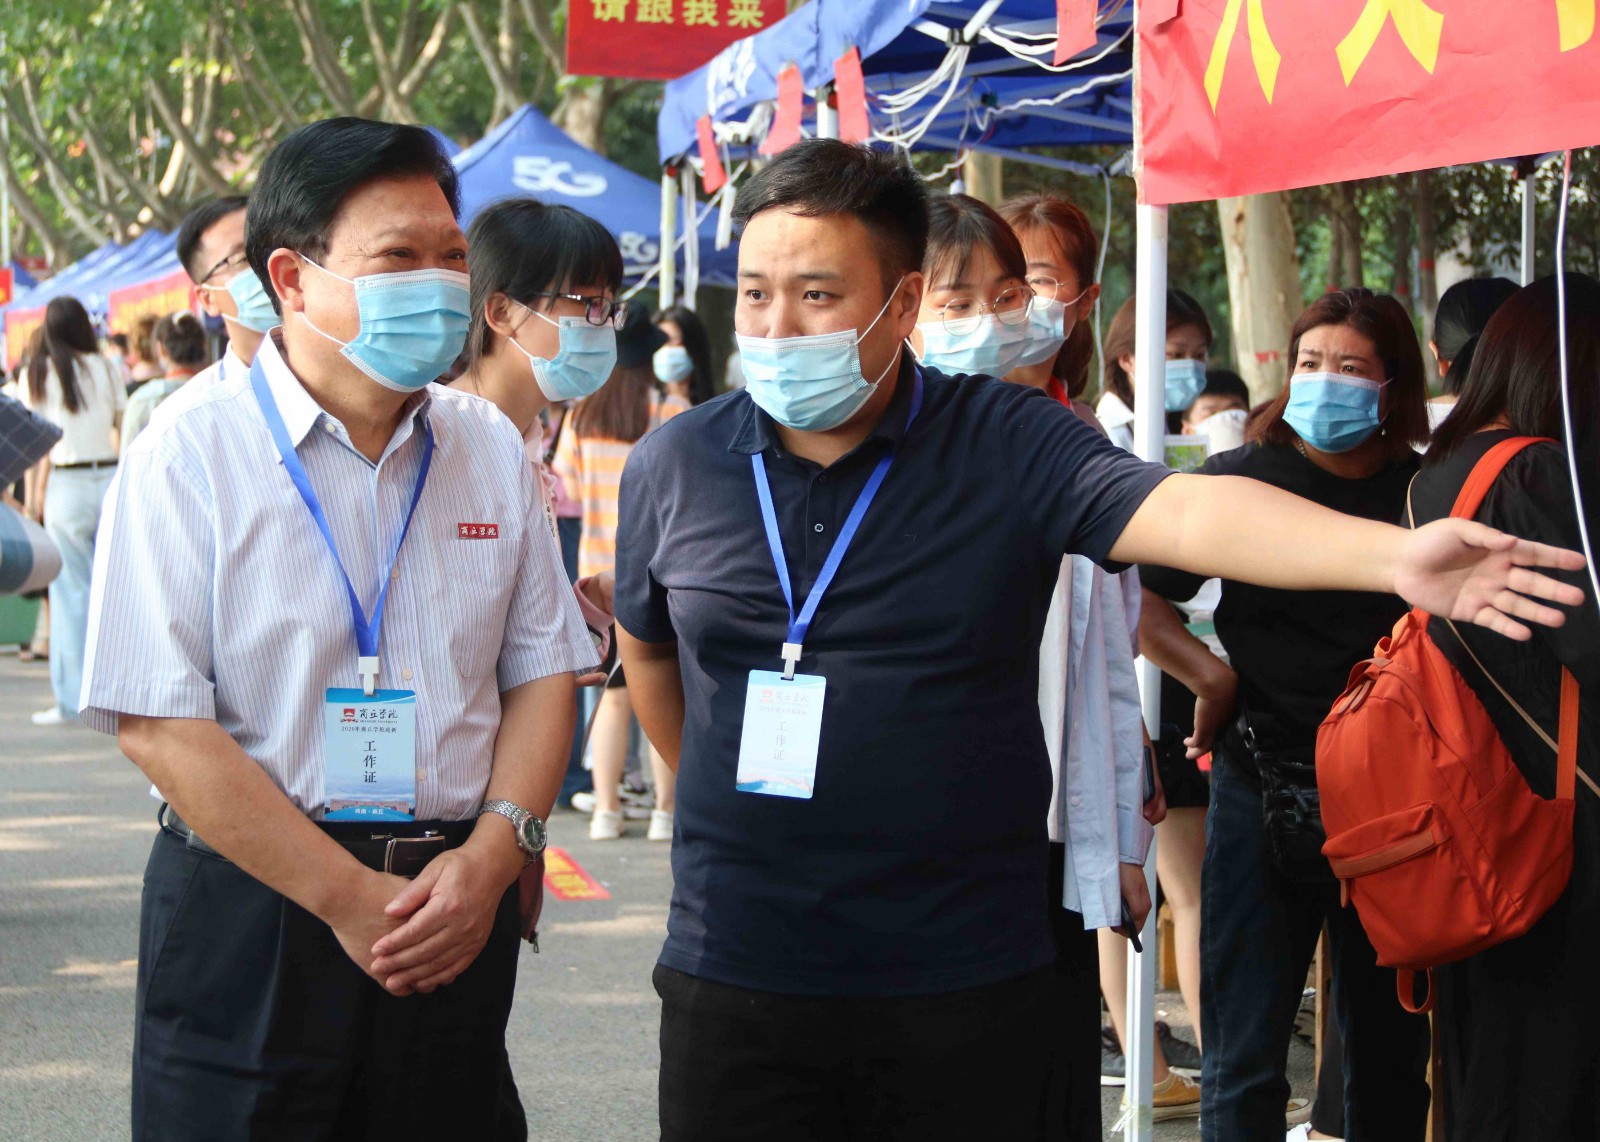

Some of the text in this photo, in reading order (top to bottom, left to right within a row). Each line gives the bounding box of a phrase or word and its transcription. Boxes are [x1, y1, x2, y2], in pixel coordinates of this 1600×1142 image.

[591, 0, 764, 28] 请跟我来
[513, 156, 608, 197] 5G
[618, 230, 659, 263] 5G
[359, 708, 398, 719] 商丘学院
[773, 720, 788, 760] 工作证
[363, 740, 377, 783] 工作证
